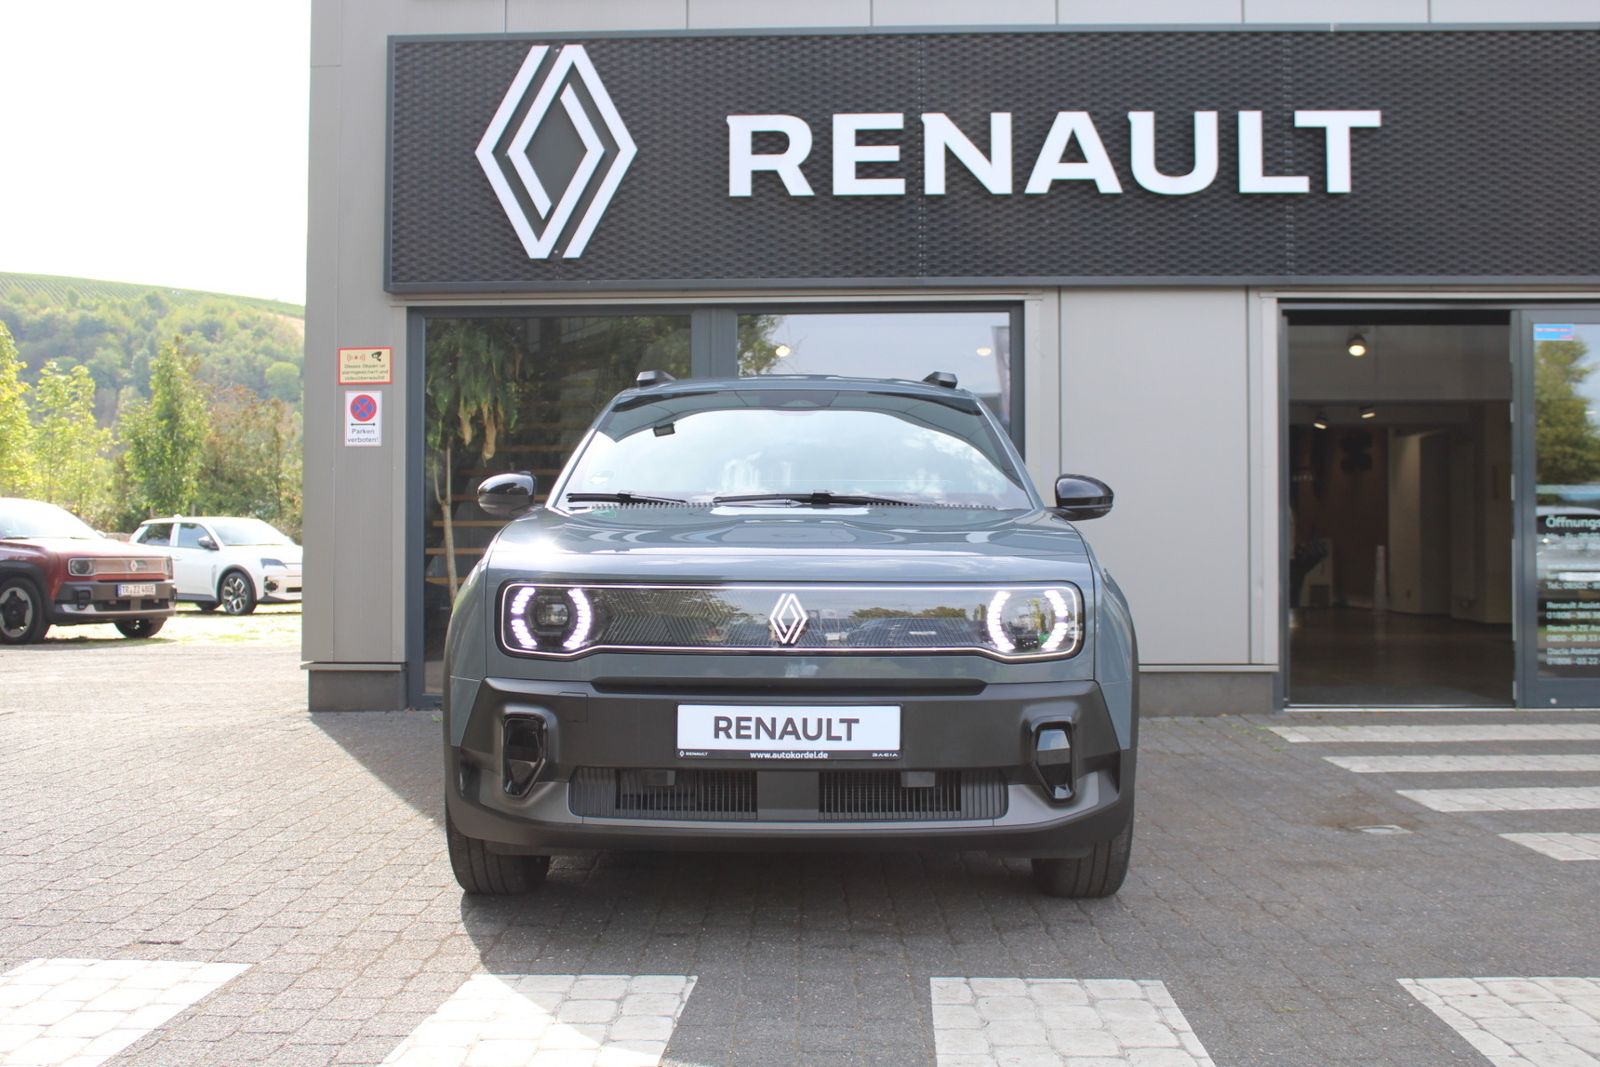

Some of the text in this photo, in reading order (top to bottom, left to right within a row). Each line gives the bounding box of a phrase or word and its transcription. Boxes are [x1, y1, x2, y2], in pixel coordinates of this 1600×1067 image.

[726, 110, 1382, 197] RENAULT
[713, 715, 860, 741] RENAULT
[750, 751, 829, 760] www.autokordel.de
